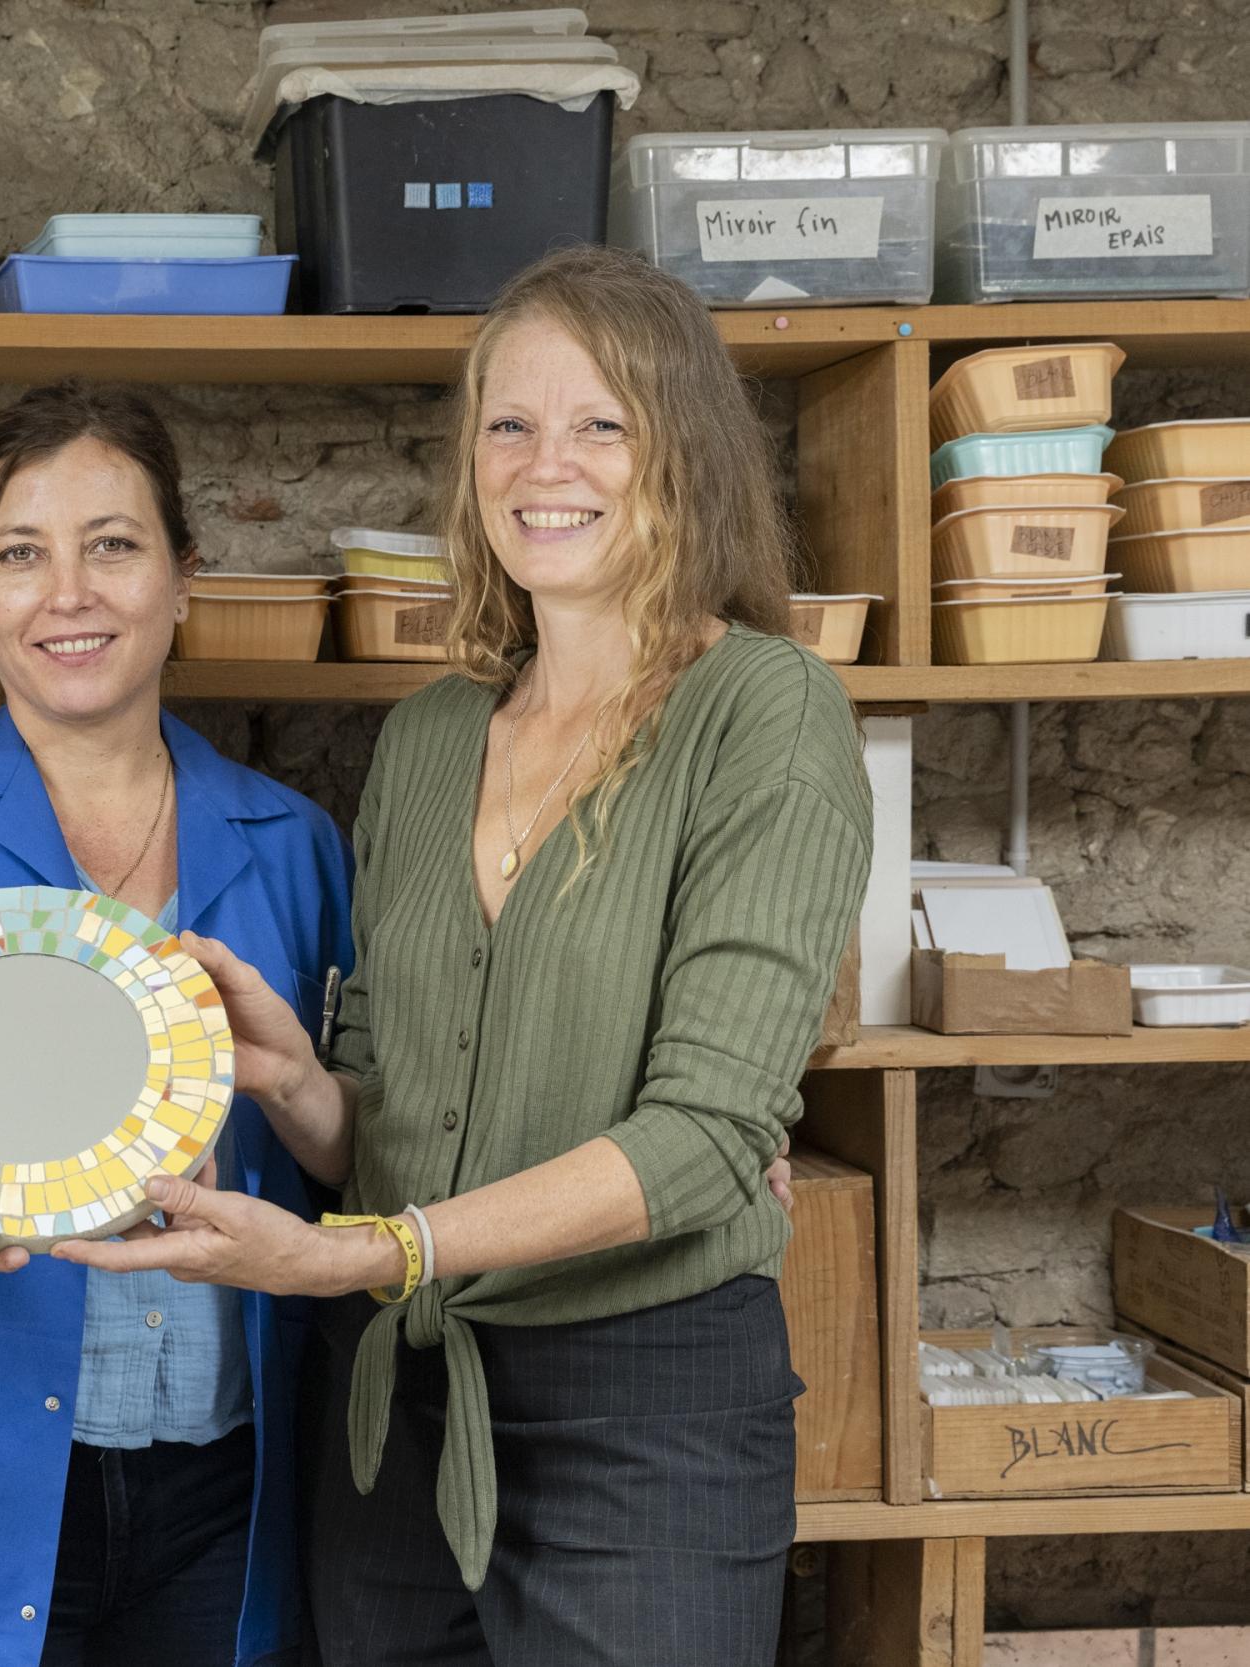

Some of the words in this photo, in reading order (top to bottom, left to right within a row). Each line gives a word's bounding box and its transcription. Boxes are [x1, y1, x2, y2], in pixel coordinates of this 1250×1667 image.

[705, 210, 777, 240] Miroir
[796, 206, 838, 237] fin
[1044, 207, 1122, 232] MIROIR
[1000, 1419, 1192, 1479] BLANC
